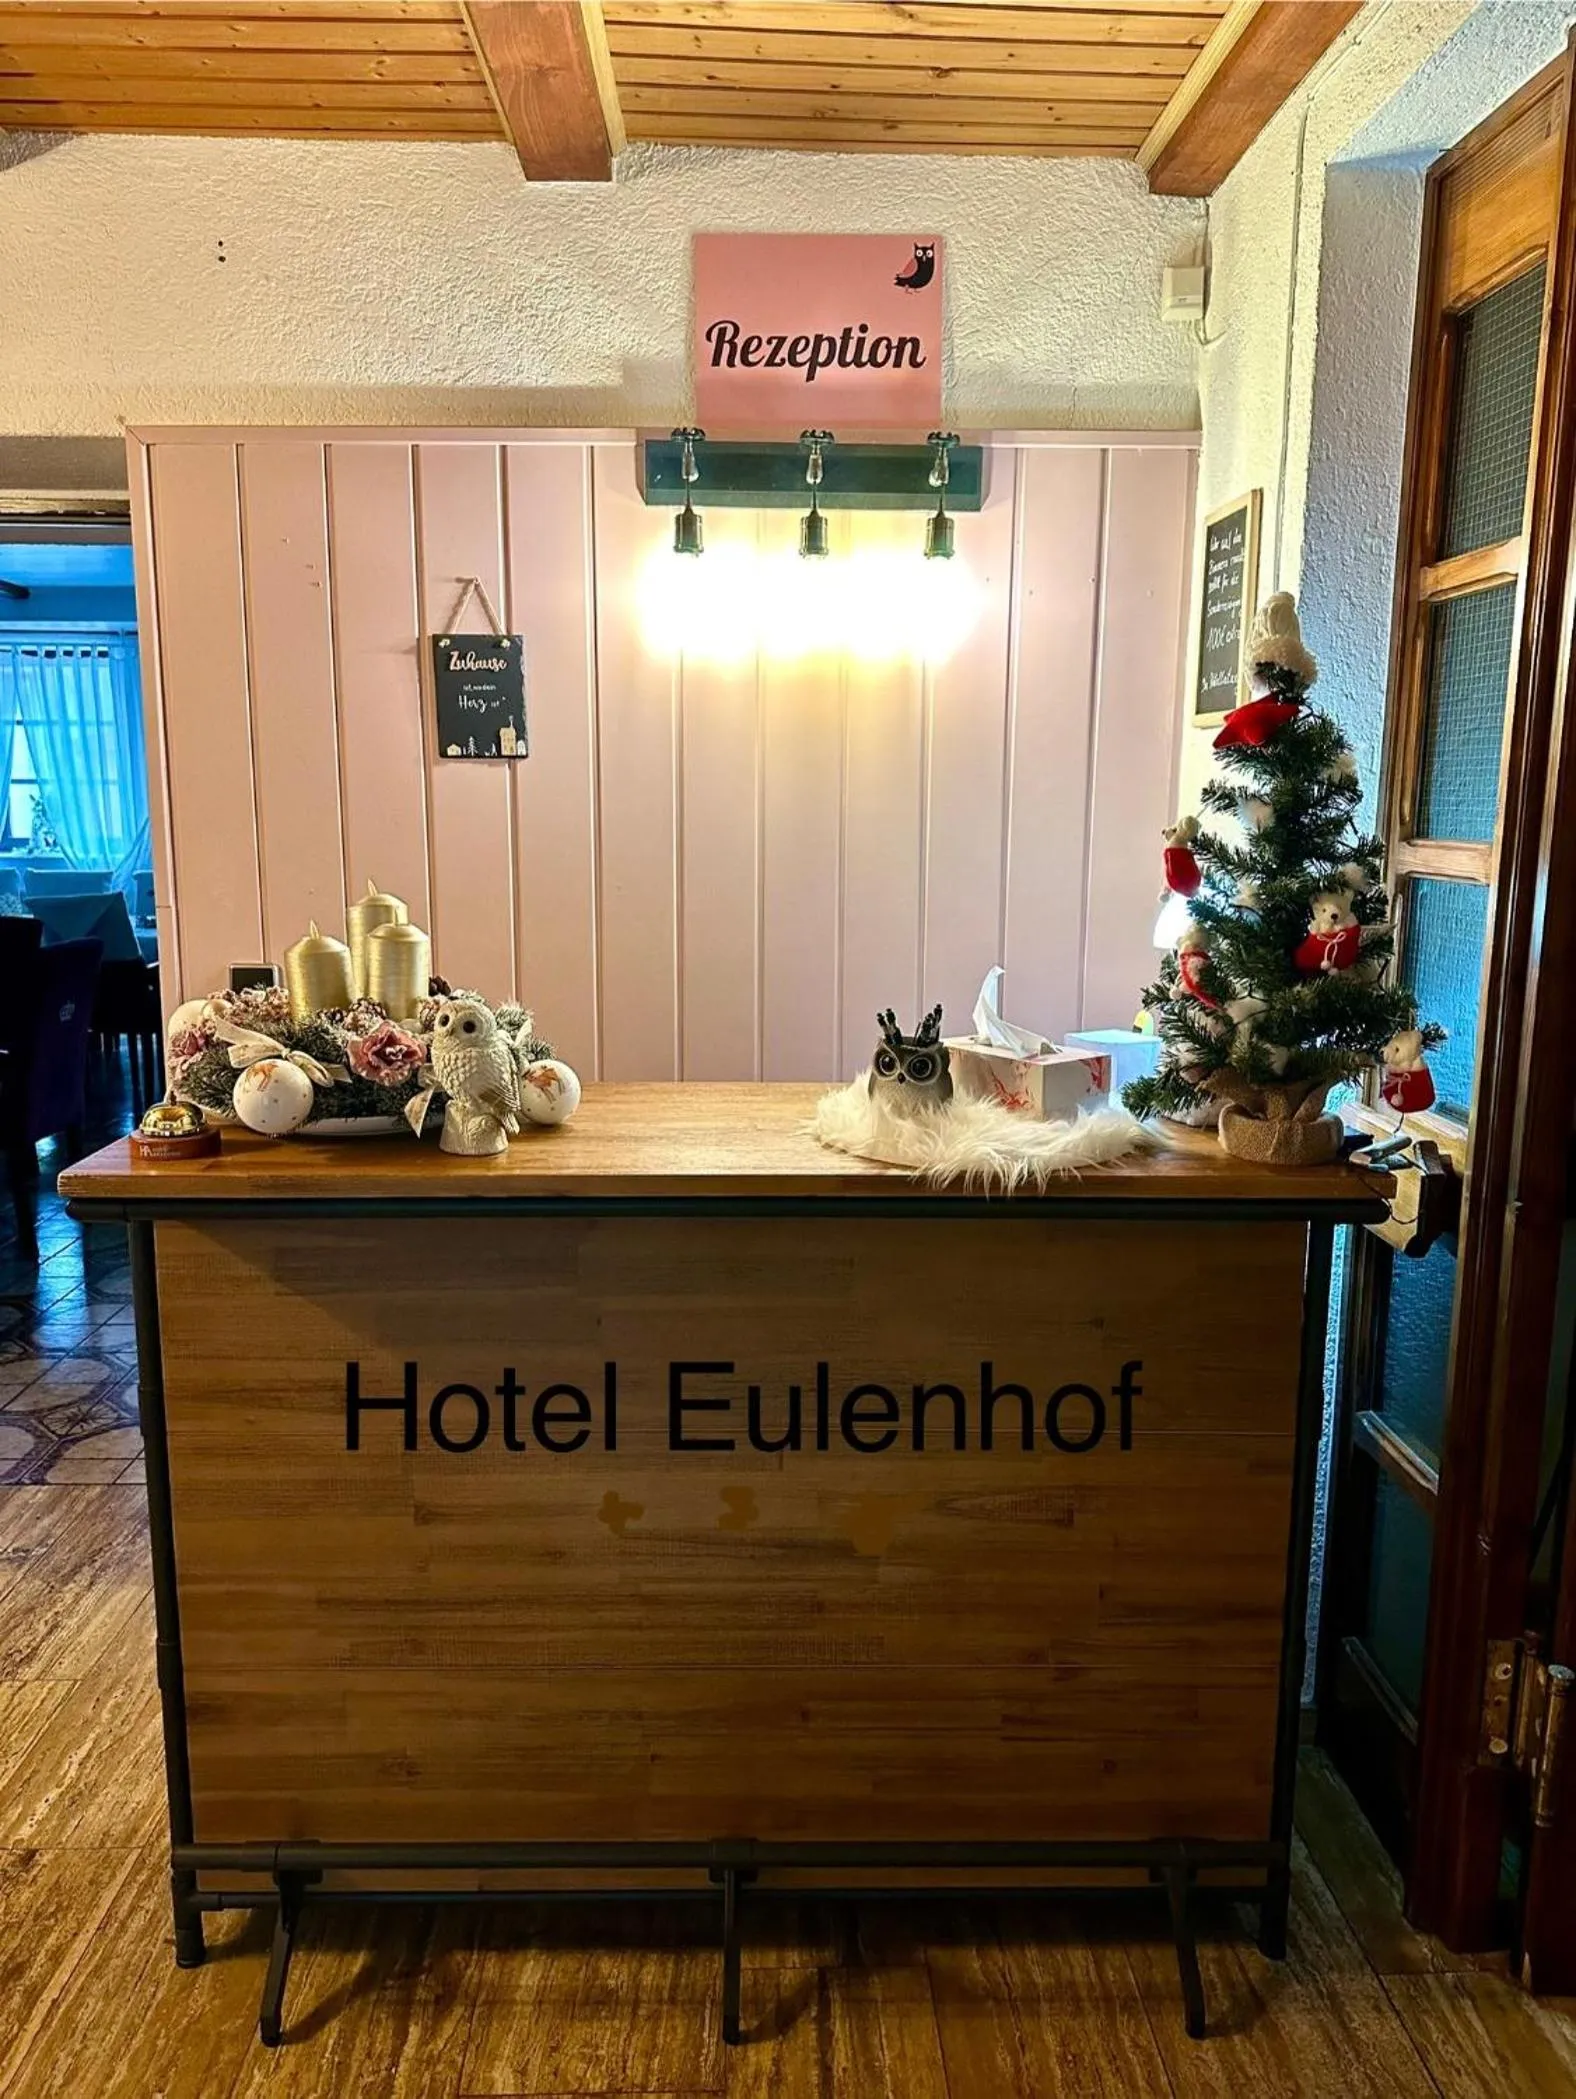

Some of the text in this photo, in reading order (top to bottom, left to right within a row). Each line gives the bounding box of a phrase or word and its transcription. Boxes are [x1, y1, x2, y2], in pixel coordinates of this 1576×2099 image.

[705, 320, 927, 382] Rezeption
[449, 650, 508, 672] Zuhause
[458, 695, 488, 714] Herz
[345, 1360, 1143, 1453] Hotel Eulenhof
